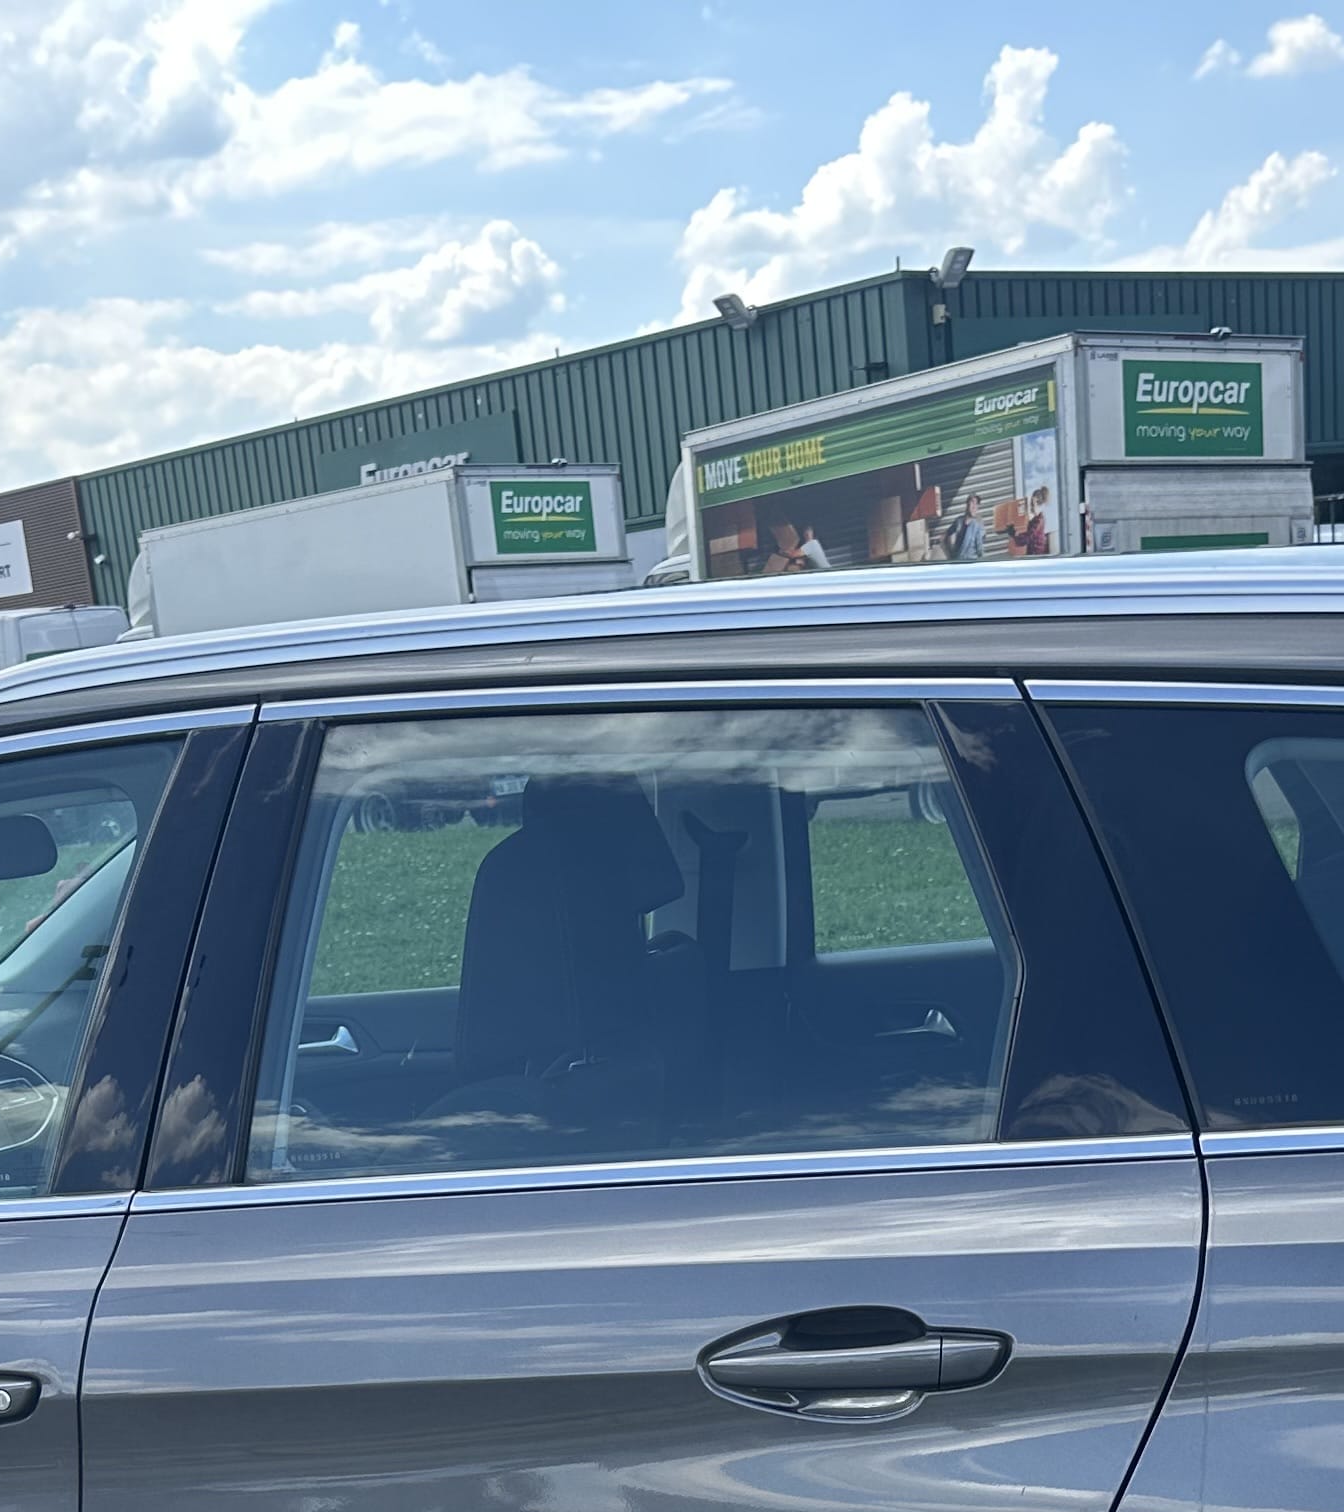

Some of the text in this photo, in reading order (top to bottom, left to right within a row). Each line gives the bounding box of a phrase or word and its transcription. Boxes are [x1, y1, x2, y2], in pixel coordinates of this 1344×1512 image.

[974, 388, 1039, 415] Europcar
[1136, 372, 1251, 415] Europcar
[1136, 423, 1251, 441] moving your way
[704, 435, 827, 491] MOVE YOUR HOME
[501, 490, 584, 521] Europcar
[503, 527, 586, 543] moving your way
